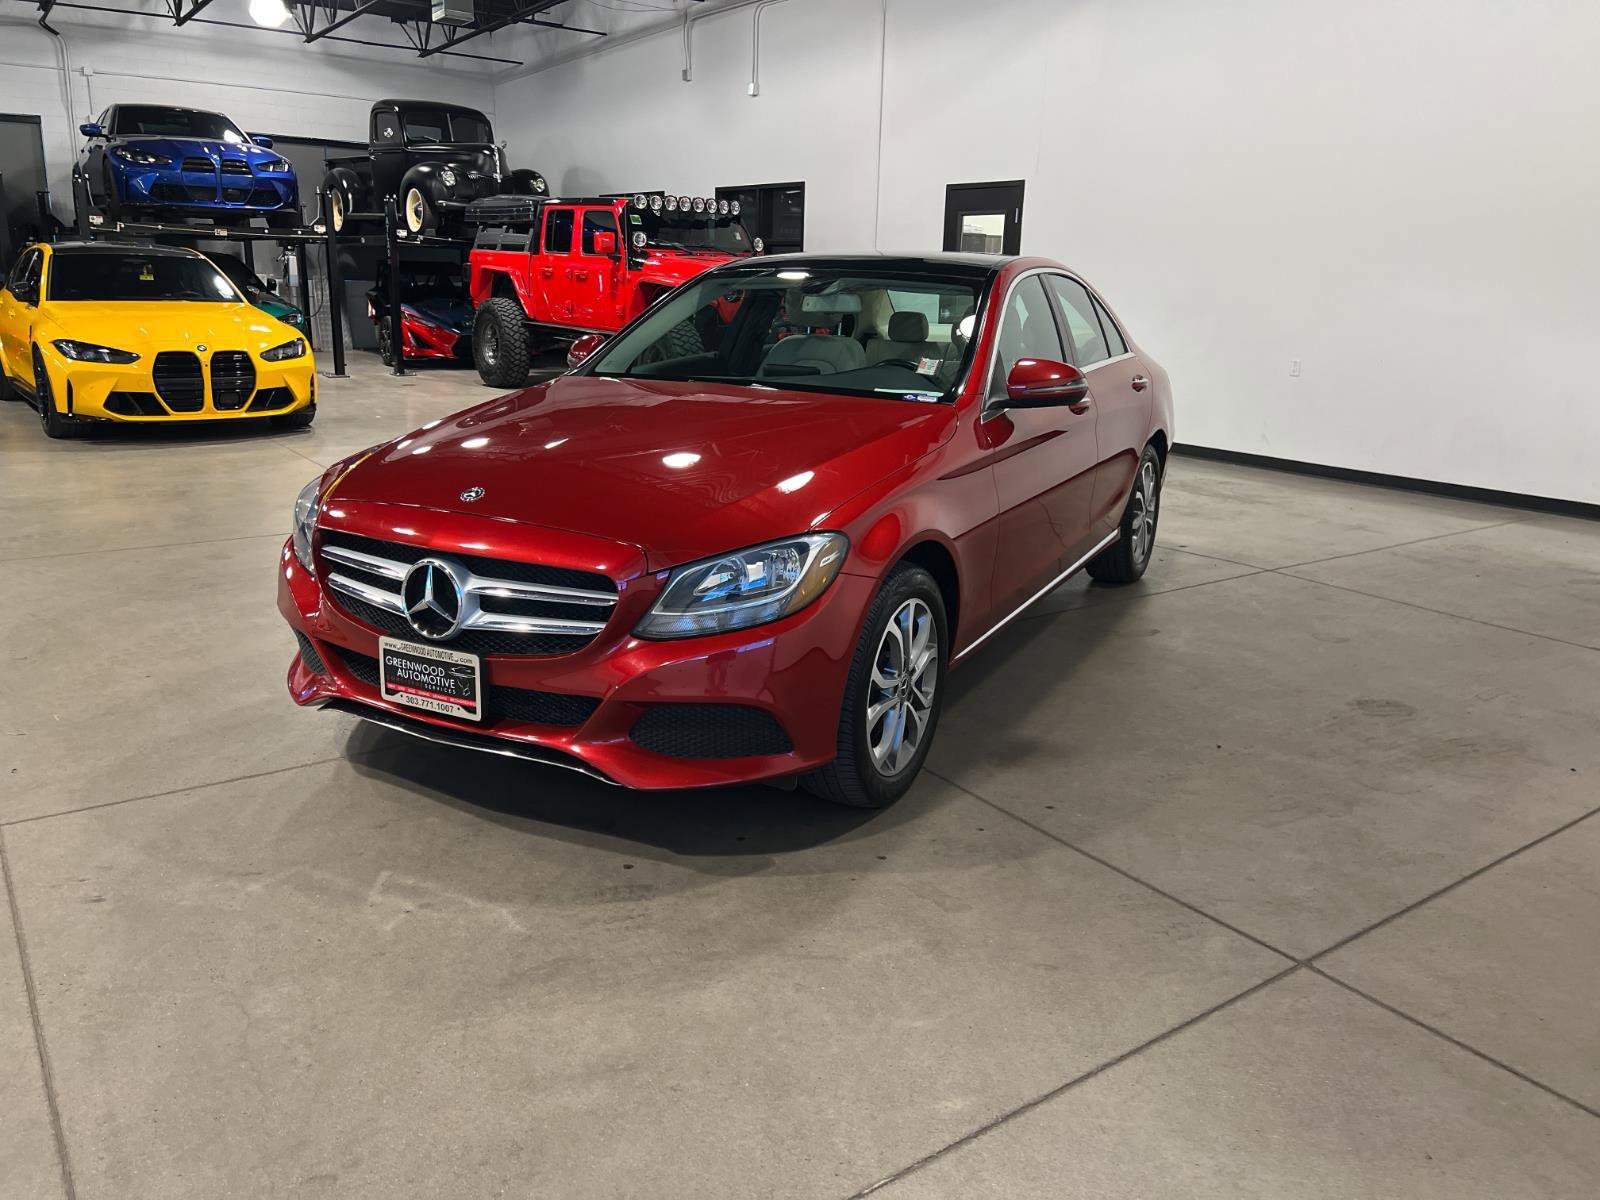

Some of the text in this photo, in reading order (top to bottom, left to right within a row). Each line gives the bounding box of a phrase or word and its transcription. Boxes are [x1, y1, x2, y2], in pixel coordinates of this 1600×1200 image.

[385, 656, 445, 677] GREENWOOD
[397, 668, 455, 689] AUTOMOTIVE
[424, 683, 456, 695] SERVICES
[405, 695, 454, 713] 303.771.1007
